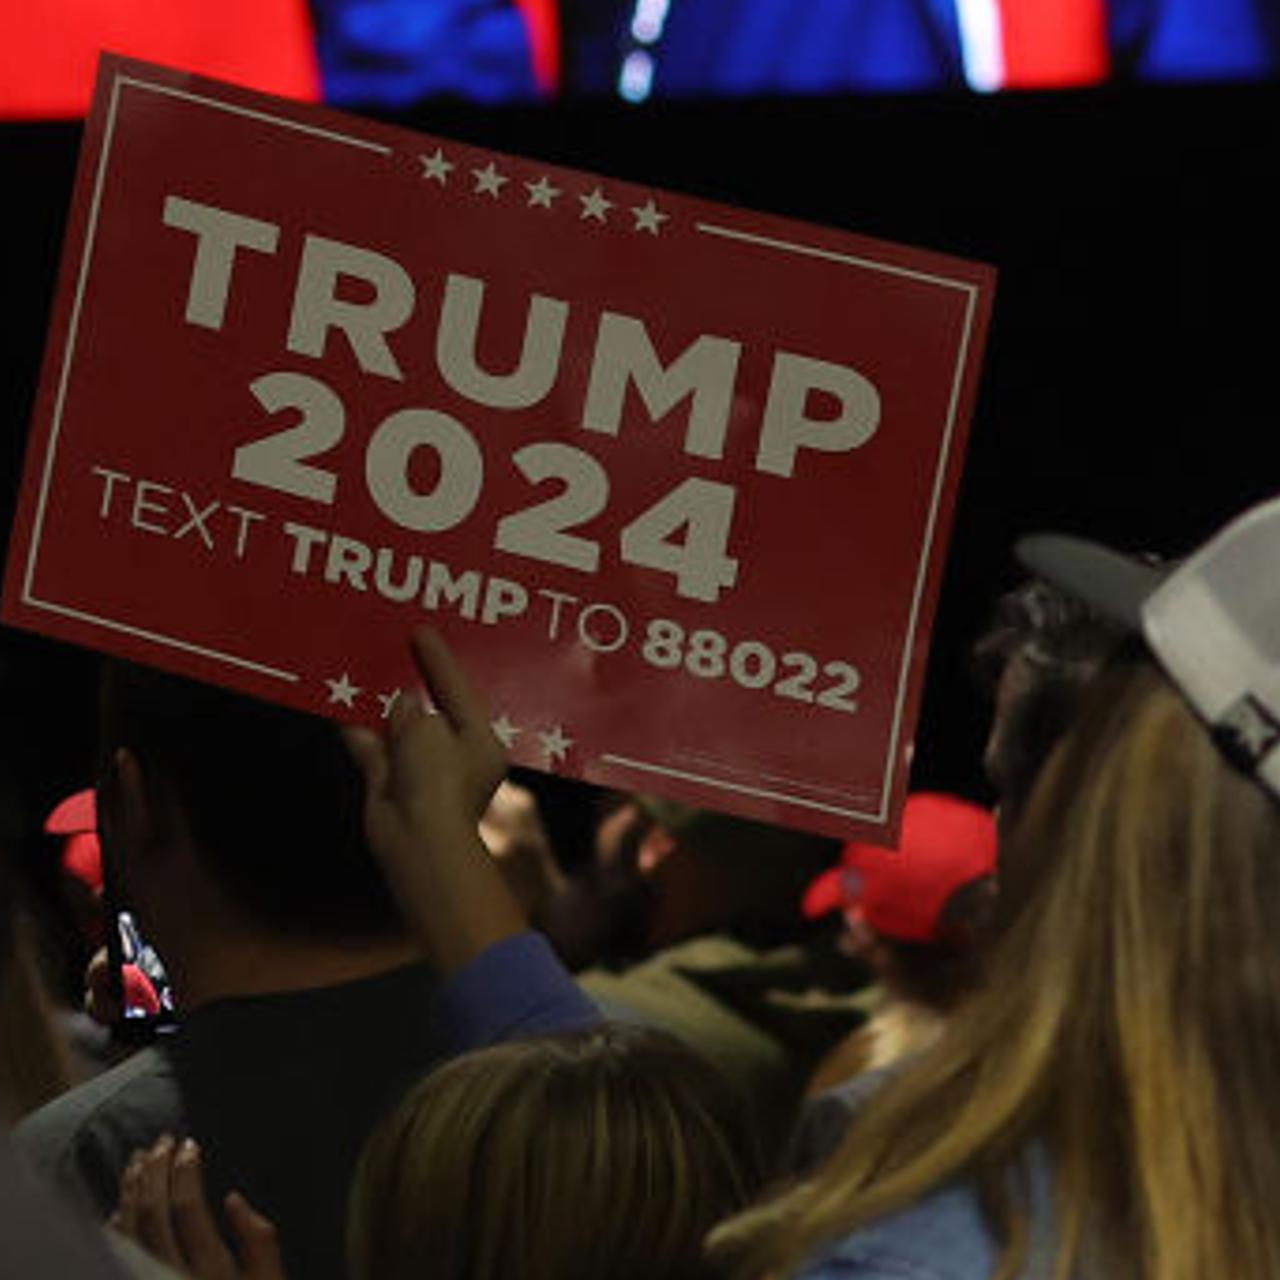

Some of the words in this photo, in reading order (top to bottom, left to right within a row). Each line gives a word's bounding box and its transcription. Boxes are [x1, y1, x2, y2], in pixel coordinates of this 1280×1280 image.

[162, 195, 881, 478] TRUMP
[91, 466, 267, 560] TEXT
[285, 522, 529, 626] TRUMP
[538, 587, 629, 653] TO
[642, 617, 860, 713] 88022
[230, 371, 739, 604] 2024
